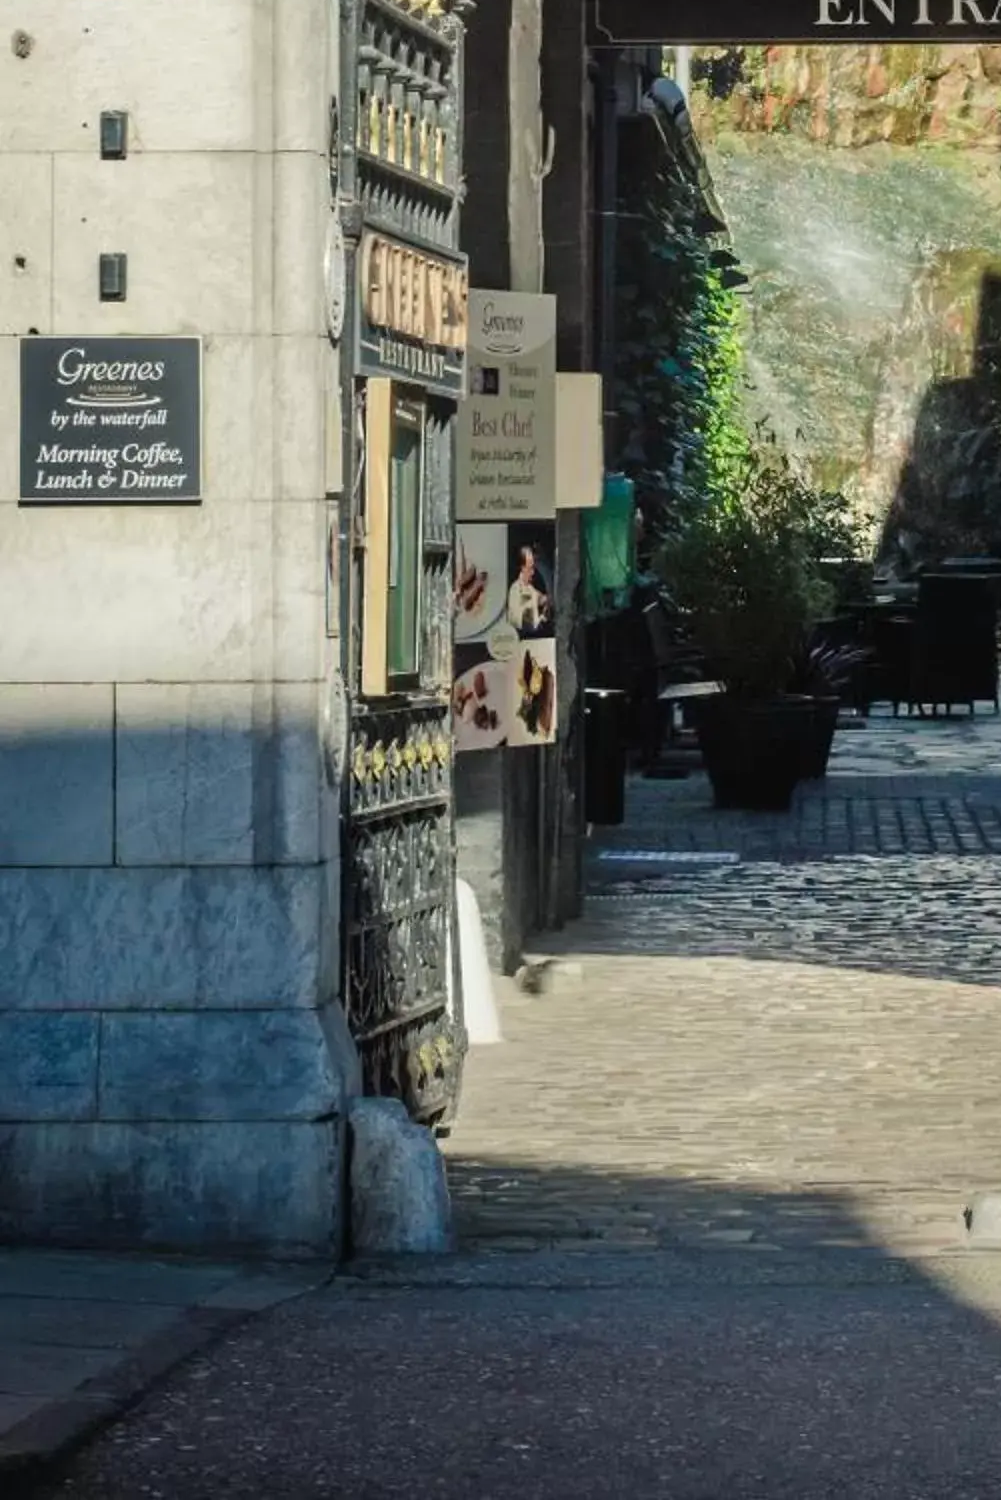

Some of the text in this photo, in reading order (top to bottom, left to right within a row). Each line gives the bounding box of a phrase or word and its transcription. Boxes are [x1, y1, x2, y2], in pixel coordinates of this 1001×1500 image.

[57, 347, 165, 385] Greenes
[51, 409, 168, 431] by the waterfall
[36, 442, 183, 469] Morning Coffee,
[35, 469, 188, 490] Lunch & Dinner
